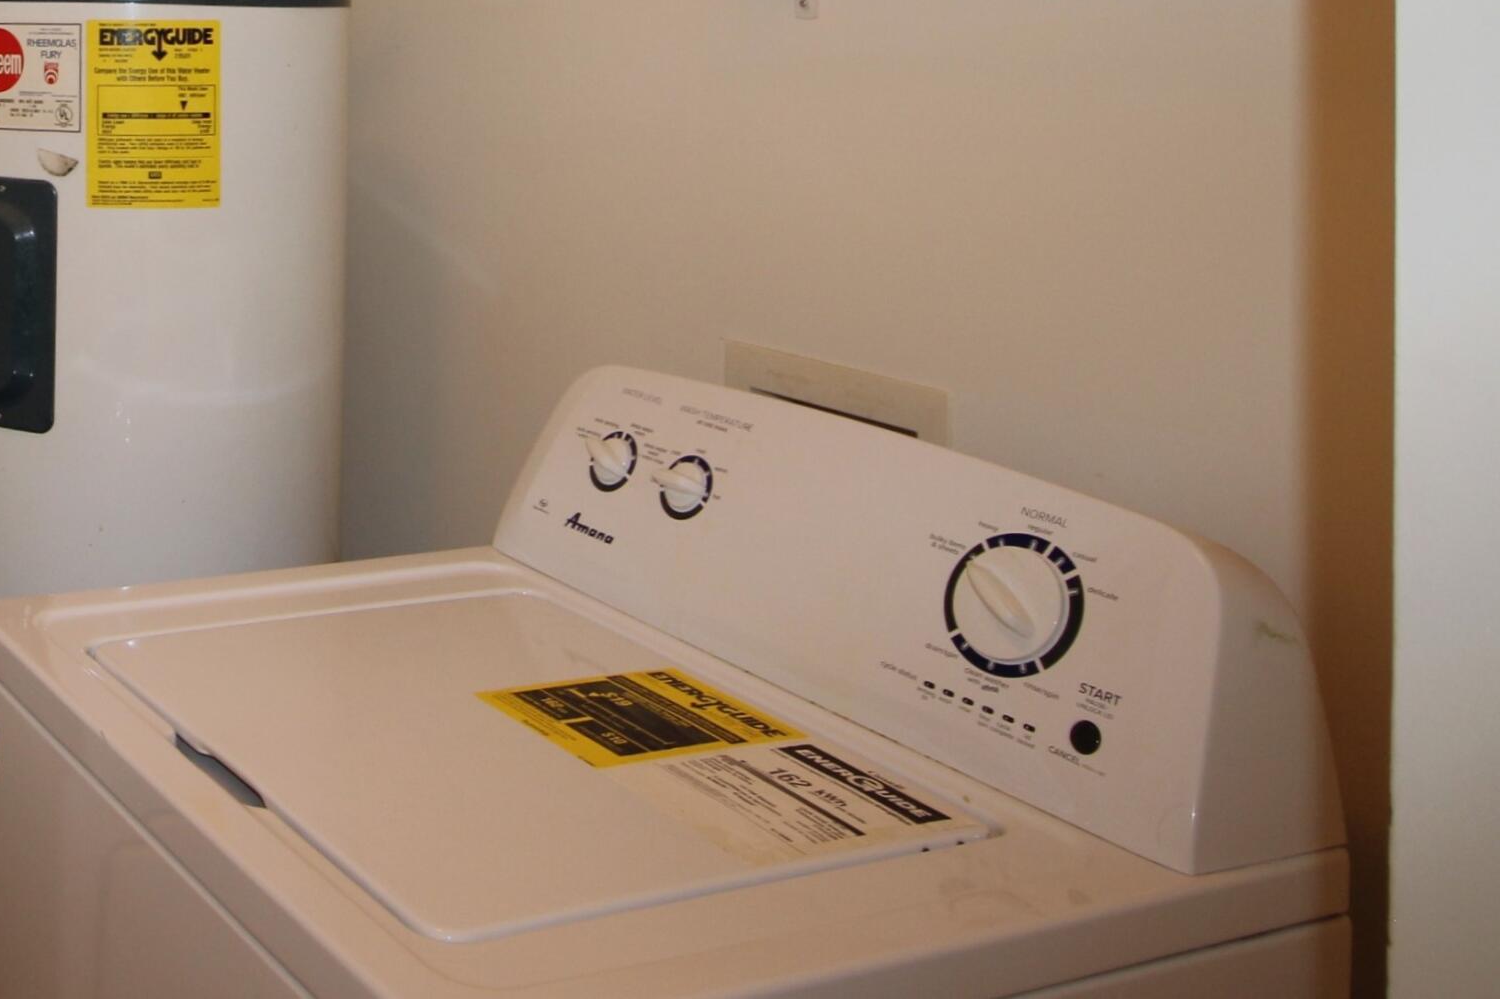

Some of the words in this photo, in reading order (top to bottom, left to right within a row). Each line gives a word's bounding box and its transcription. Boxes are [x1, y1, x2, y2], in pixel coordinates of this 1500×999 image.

[99, 27, 214, 47] ENERGYGUIDE
[564, 512, 615, 544] Amana
[1020, 506, 1068, 529] NORMAL
[1087, 586, 1119, 601] delicate
[1079, 682, 1122, 706] START
[1048, 745, 1081, 767] CANCEL
[768, 767, 813, 789] 162
[794, 749, 934, 819] ENERGUIDE
